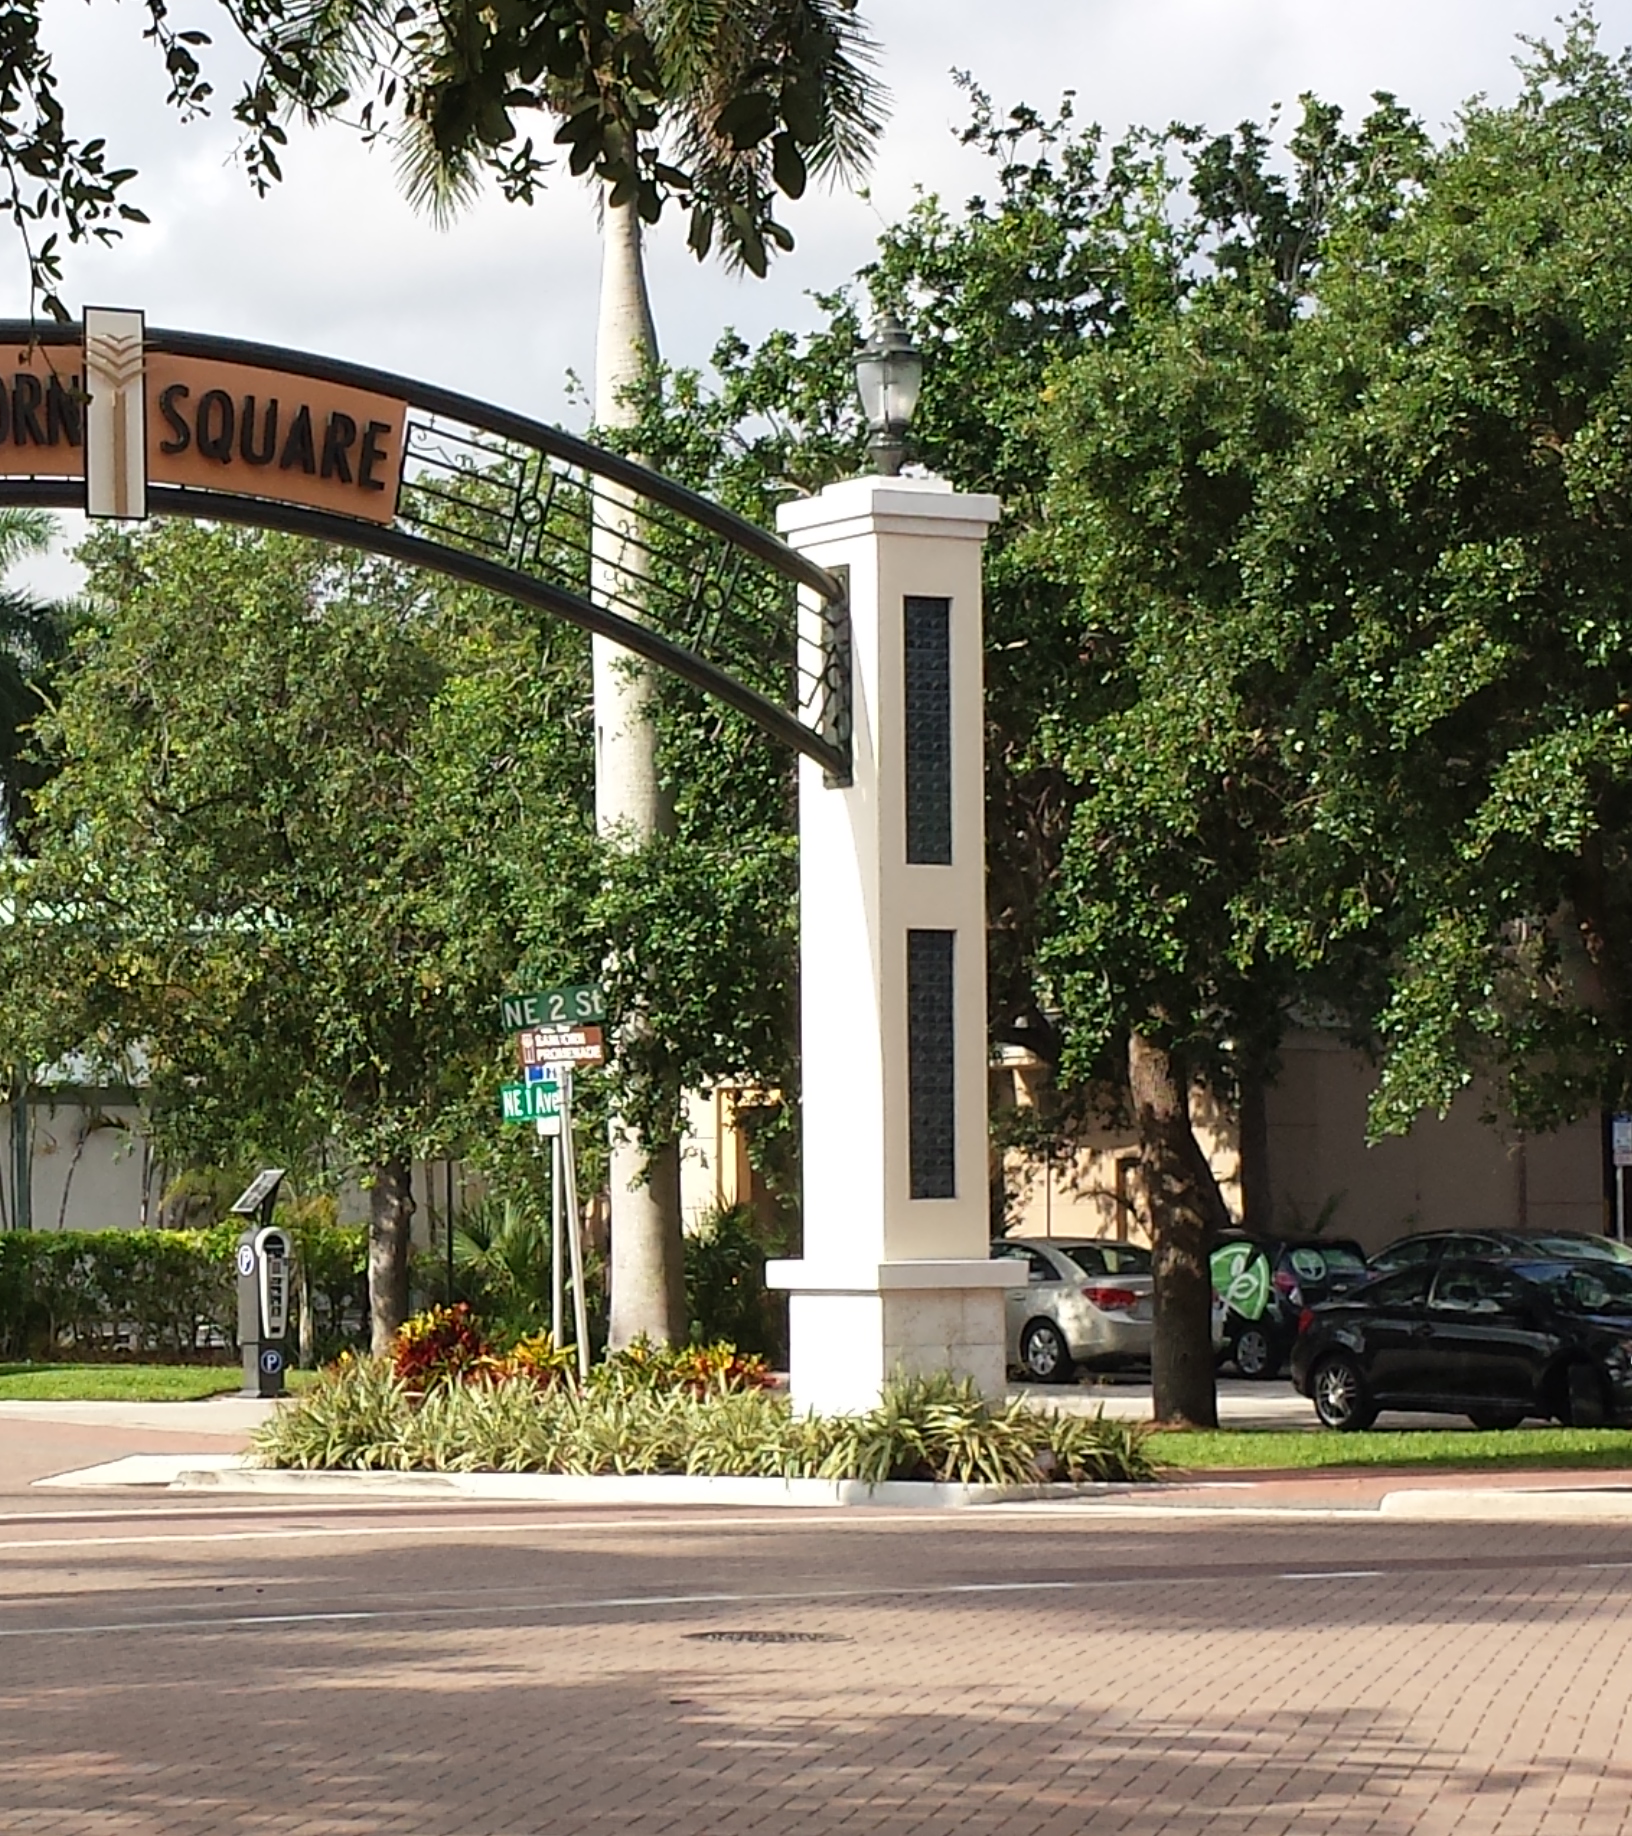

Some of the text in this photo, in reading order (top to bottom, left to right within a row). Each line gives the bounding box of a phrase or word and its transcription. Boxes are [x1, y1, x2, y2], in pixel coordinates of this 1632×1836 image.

[159, 384, 392, 491] SQUARE
[504, 989, 604, 1027] NE 2 St
[502, 1087, 561, 1117] NE 1 Ave
